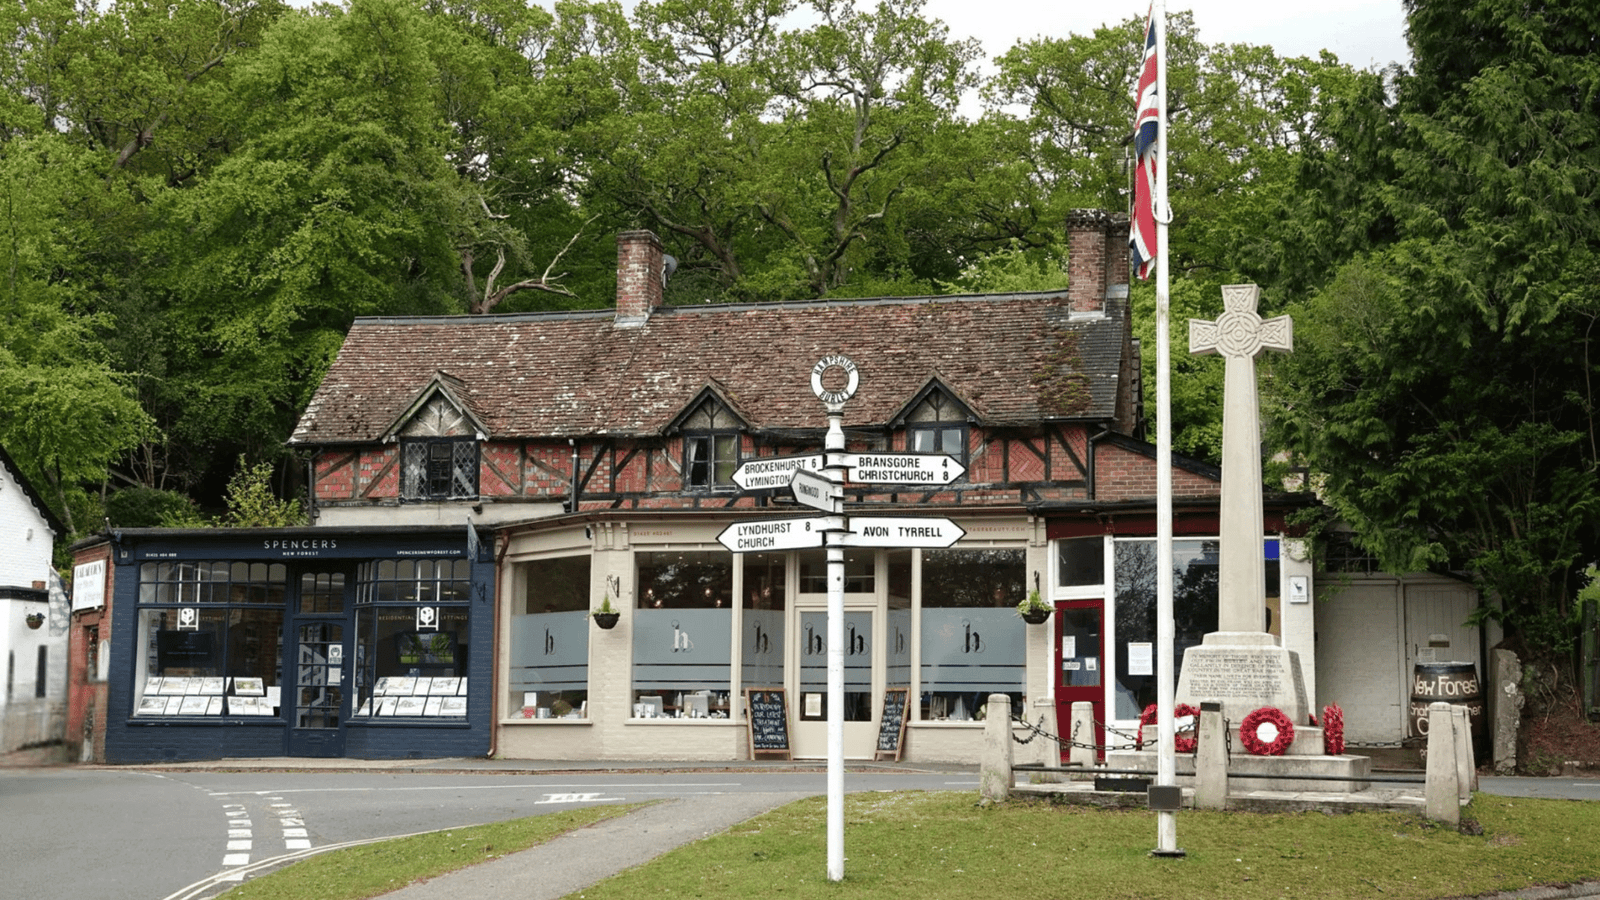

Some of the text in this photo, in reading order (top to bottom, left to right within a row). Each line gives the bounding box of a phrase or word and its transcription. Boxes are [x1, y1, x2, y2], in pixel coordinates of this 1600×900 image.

[813, 355, 857, 375] HAMPSHIRE
[819, 389, 852, 404] BURLEY
[745, 458, 817, 474] BROCKENHURST 6
[859, 457, 948, 469] BRANSGORE 4
[745, 474, 790, 488] LYMINGTON
[858, 470, 949, 481] CHRISTCHURCH 8
[738, 521, 811, 536] LYNDHURST 8
[863, 527, 943, 538] AVON TYRRELL
[264, 540, 337, 549] SPENCERS
[738, 537, 775, 549] CHURCH
[1413, 674, 1436, 695] New
[1410, 702, 1430, 717] Snak
